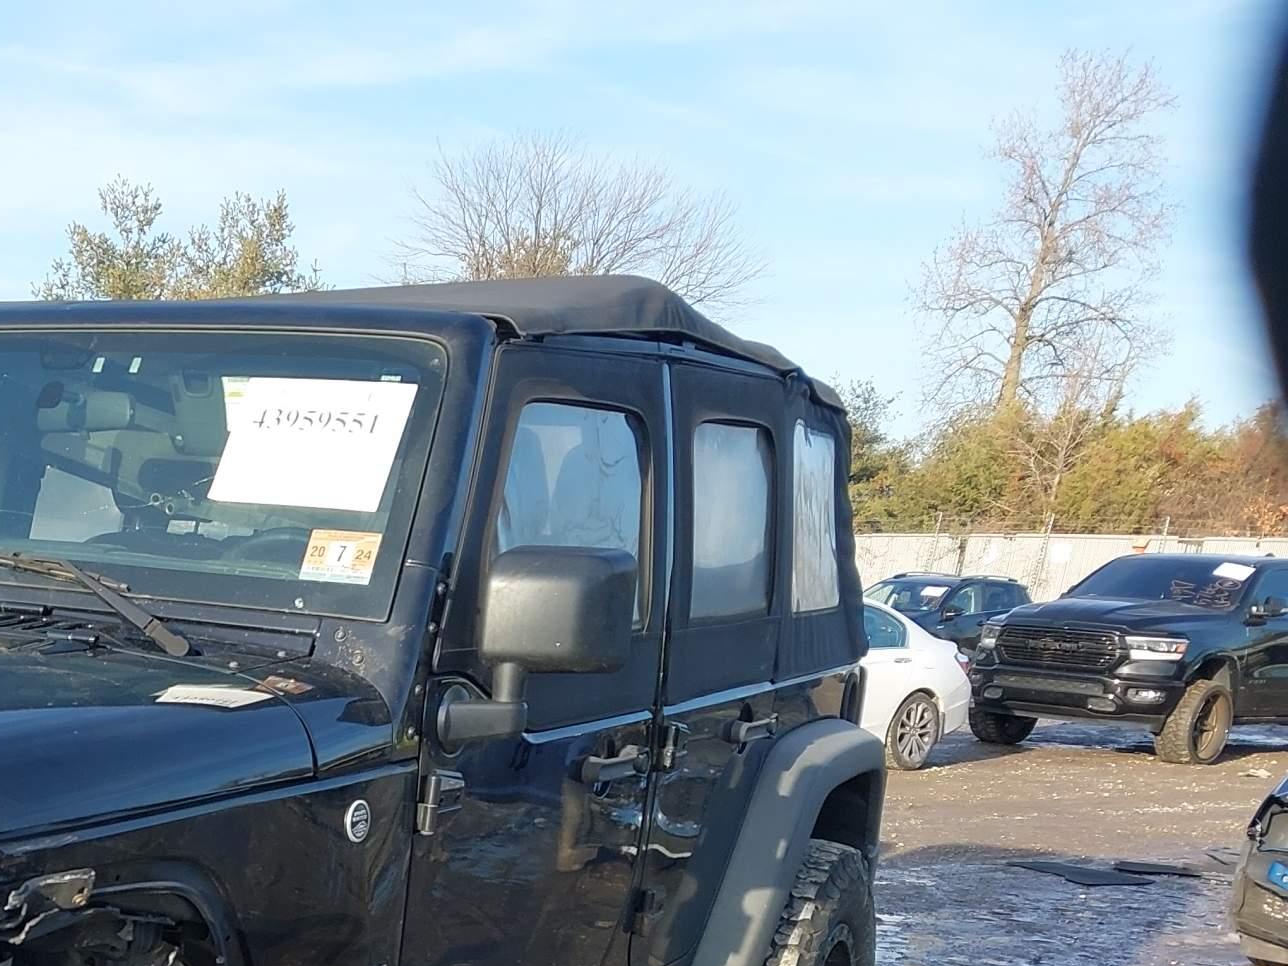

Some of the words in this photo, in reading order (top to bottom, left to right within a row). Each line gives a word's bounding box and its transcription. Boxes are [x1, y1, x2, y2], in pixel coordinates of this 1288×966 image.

[253, 409, 379, 433] 43959551
[310, 545, 326, 558] 20
[336, 545, 348, 562] 7
[355, 549, 372, 561] 24
